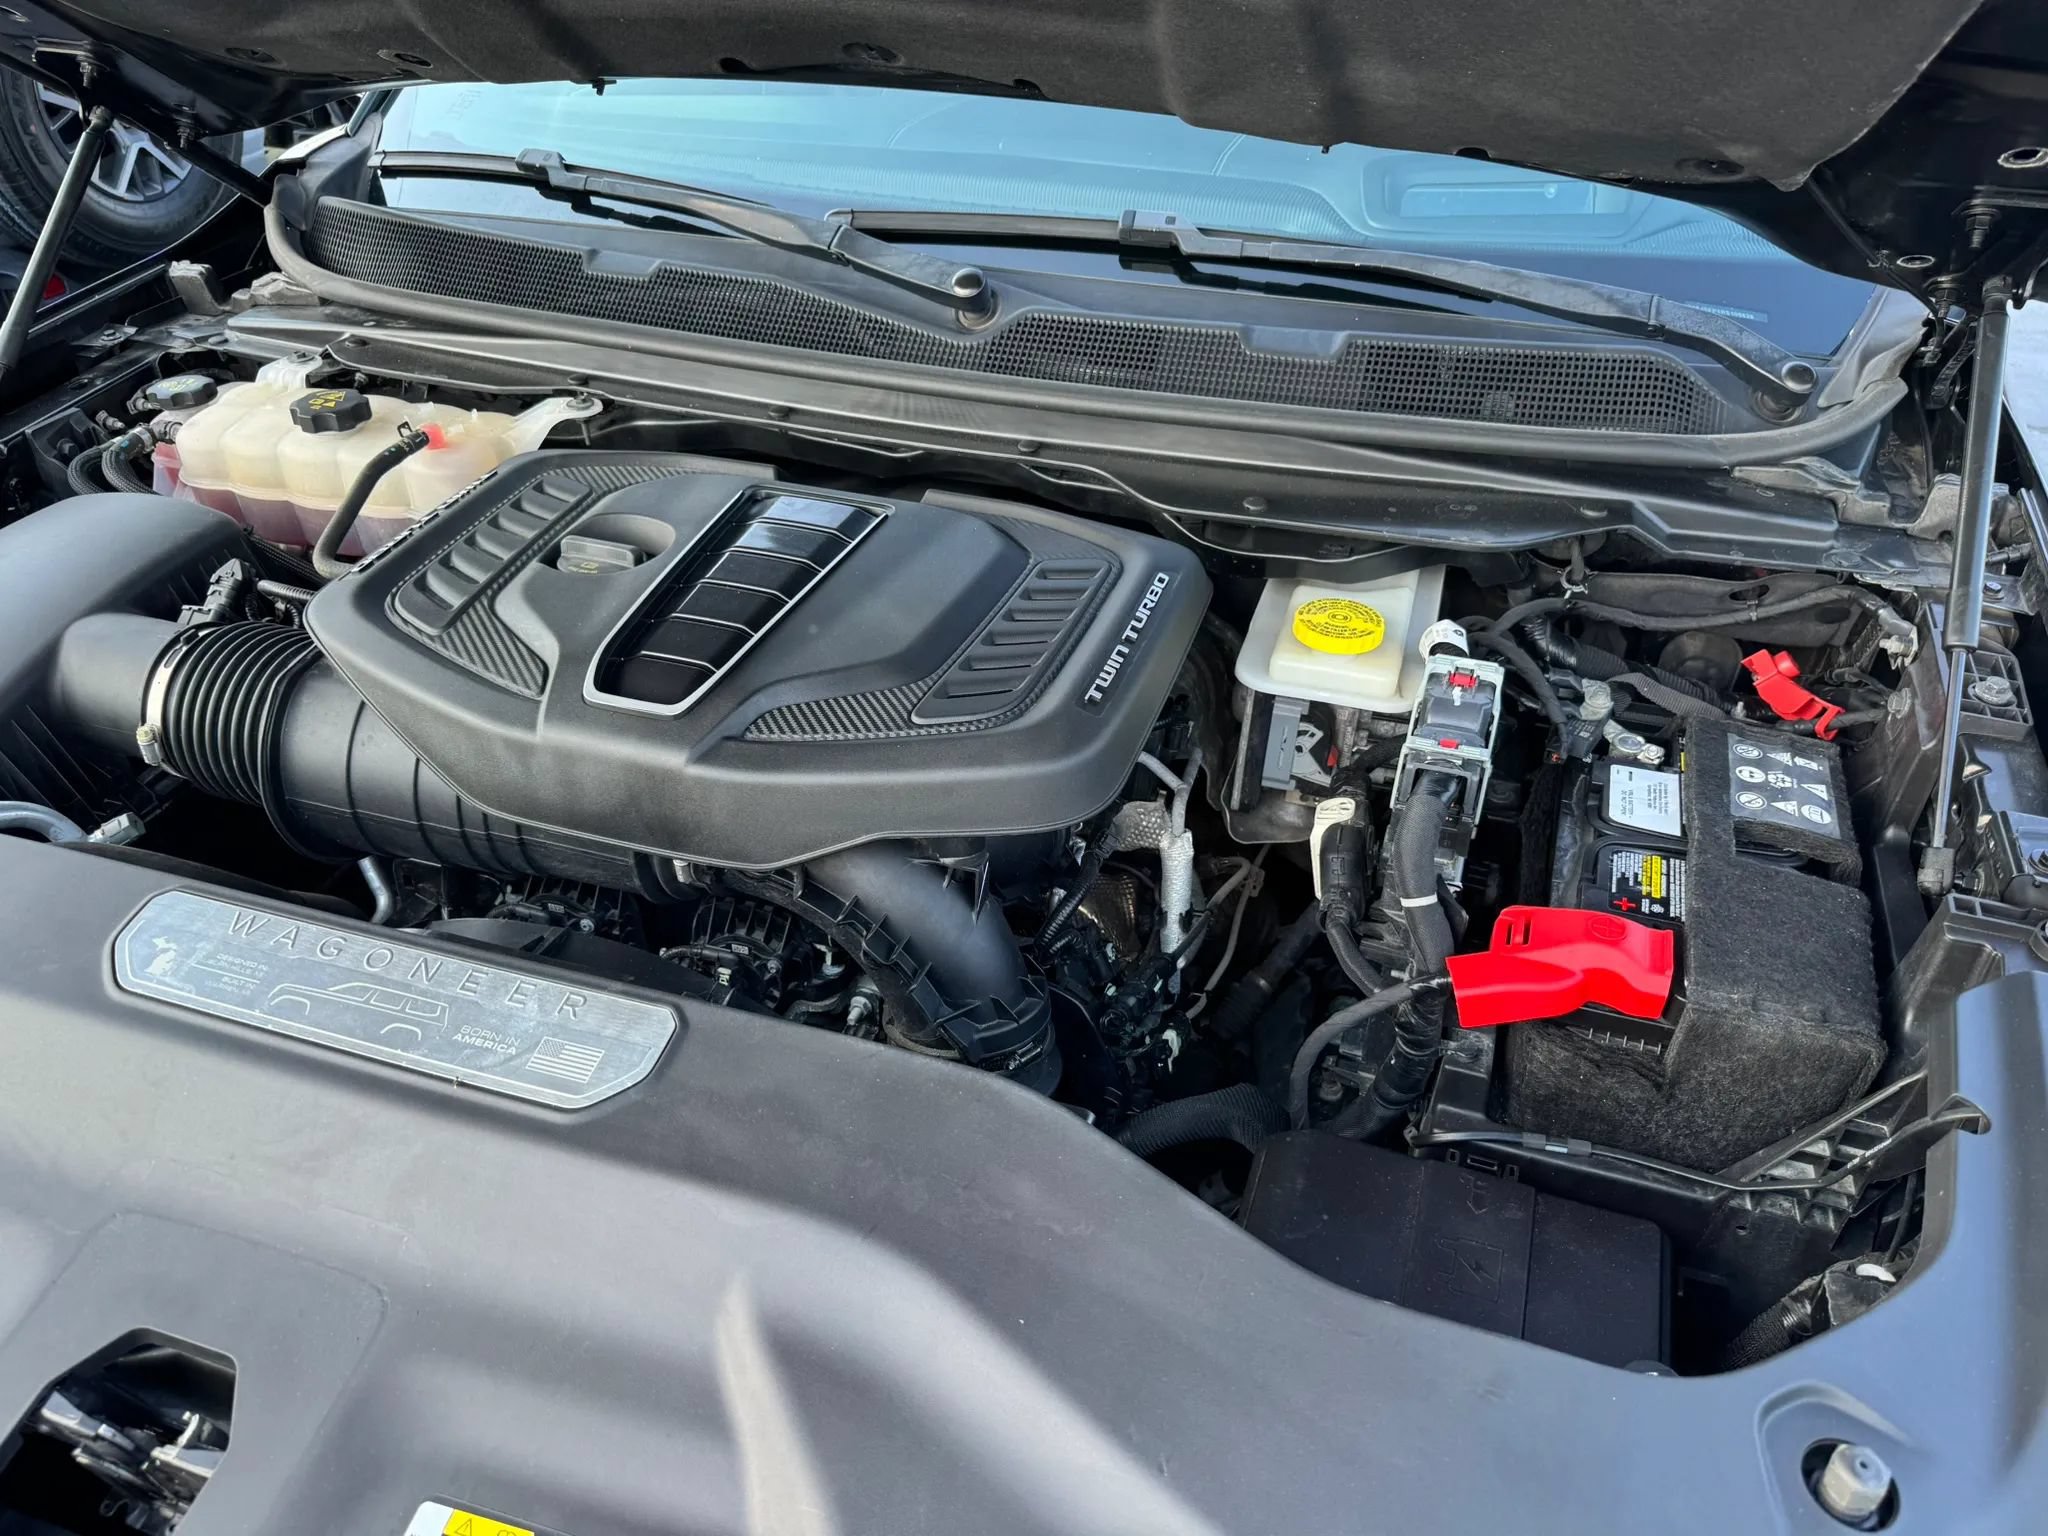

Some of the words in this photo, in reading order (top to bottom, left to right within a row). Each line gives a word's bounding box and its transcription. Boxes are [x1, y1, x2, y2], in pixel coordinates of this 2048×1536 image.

[1084, 644, 1130, 704] TWIN
[1121, 572, 1170, 643] TURBO
[227, 911, 589, 1021] WAGONEER
[452, 1033, 517, 1056] AMERICA
[460, 1024, 502, 1041] BORN
[505, 1036, 521, 1047] IN
